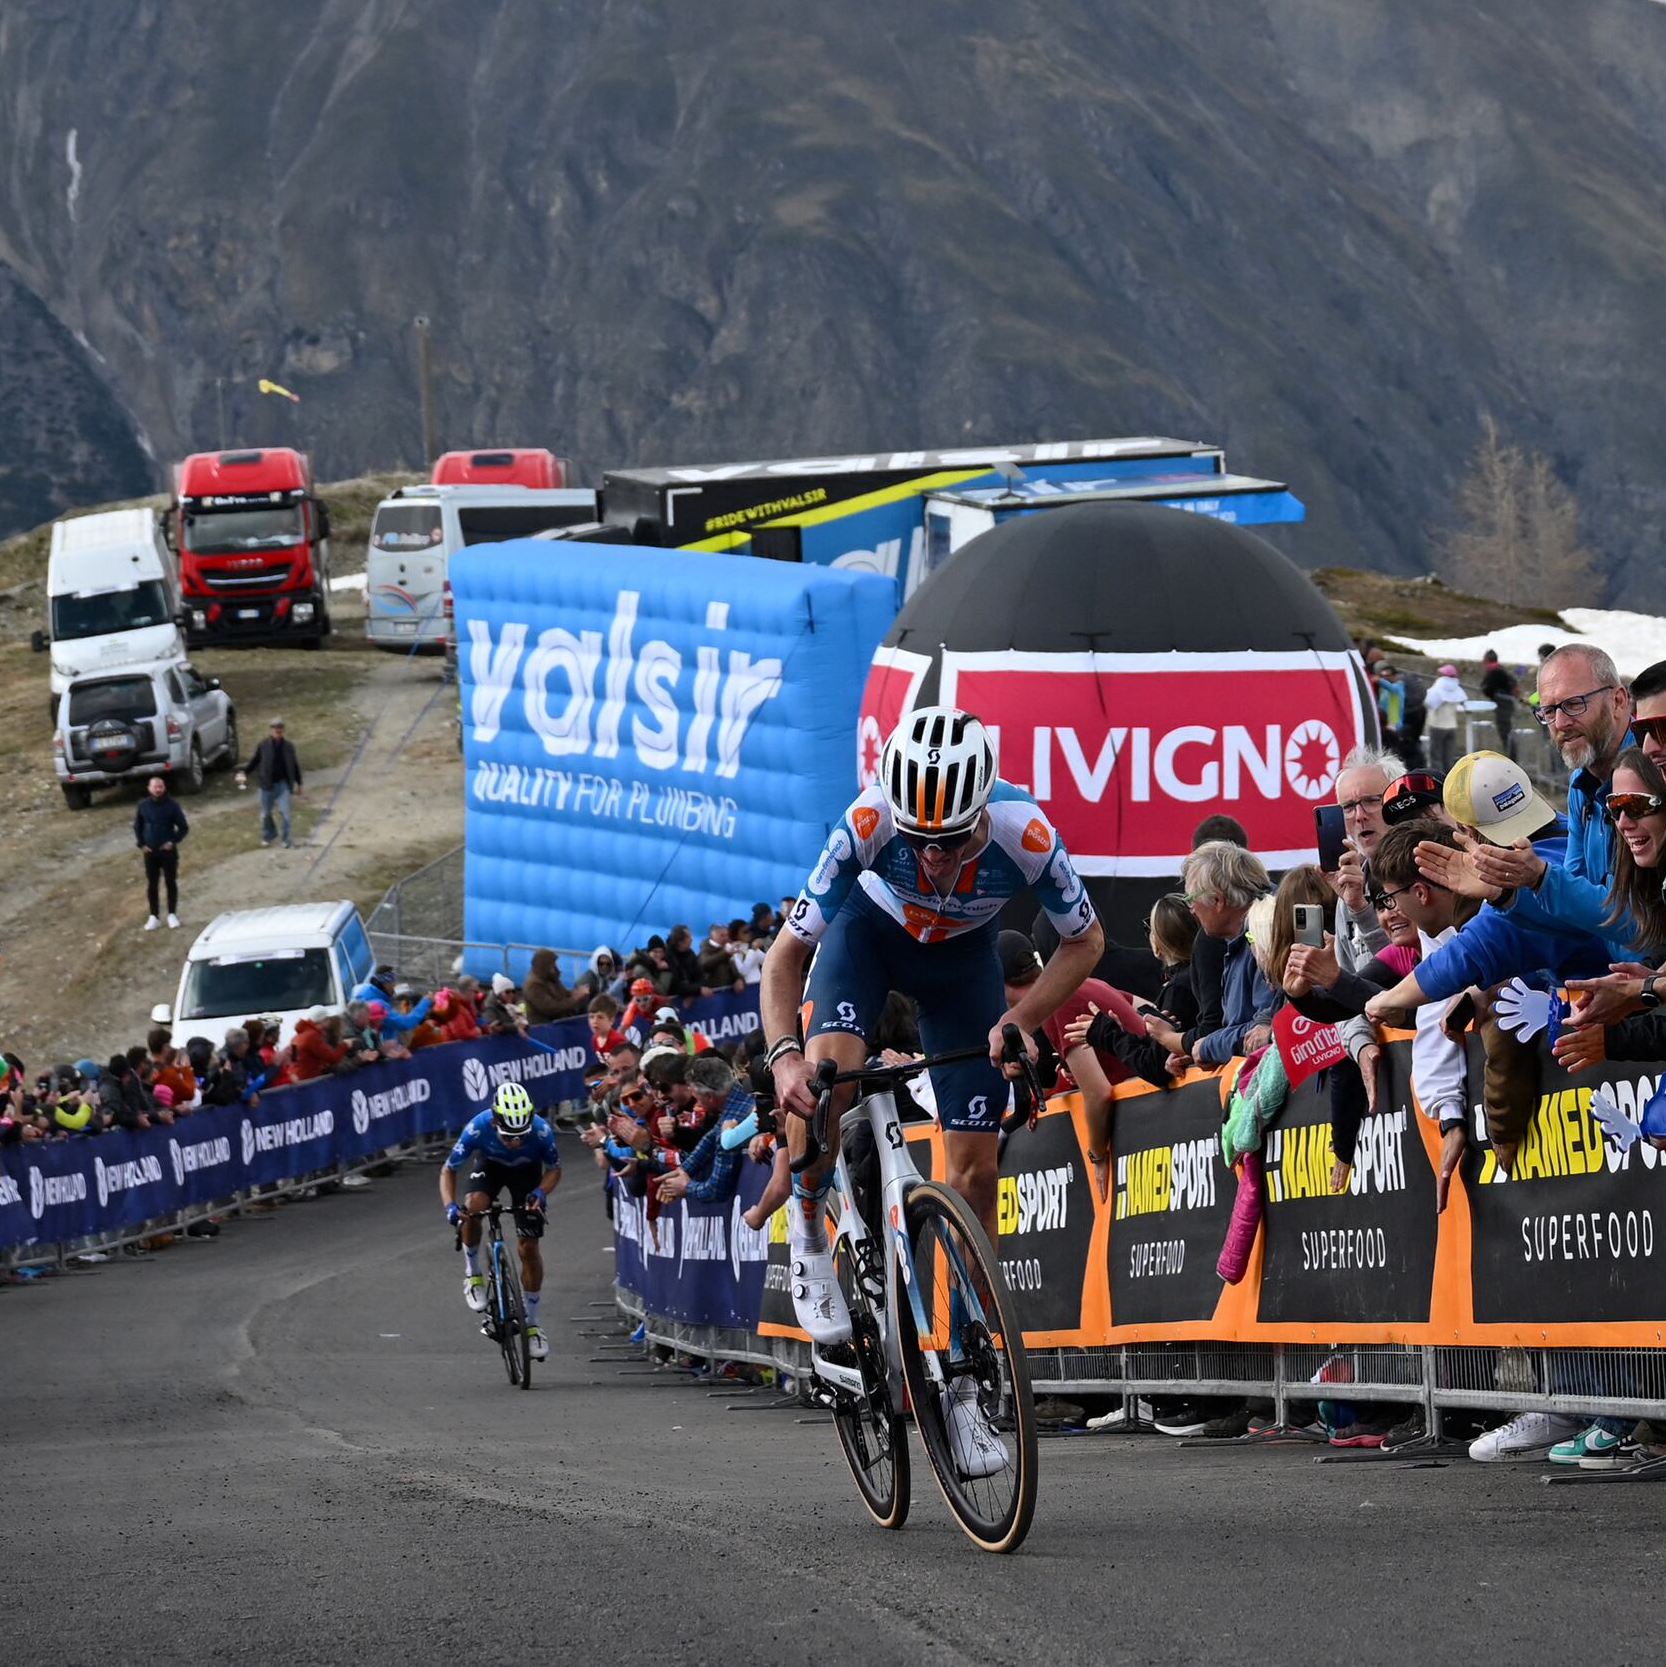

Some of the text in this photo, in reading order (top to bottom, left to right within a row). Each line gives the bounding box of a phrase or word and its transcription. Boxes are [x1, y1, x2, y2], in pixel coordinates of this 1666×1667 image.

[705, 487, 828, 533] #RIDEWITHVALSIR
[467, 590, 782, 779] valsir
[473, 760, 573, 810] QUALITY
[574, 774, 625, 818] FOR
[1388, 795, 1417, 813] INEOS
[684, 1011, 759, 1040] OLLAND
[1290, 1026, 1341, 1065] Giro d'Ita
[488, 1046, 587, 1088] NEW HOLLAND
[368, 1091, 391, 1121] NEW
[949, 1118, 997, 1127] SCOTT
[255, 1109, 334, 1154] NEW HOLLAND
[1301, 1227, 1386, 1271] SUPERFOOD
[1521, 1209, 1654, 1262] SUPERFOOD
[1129, 1239, 1185, 1278] SUPERFOOD
